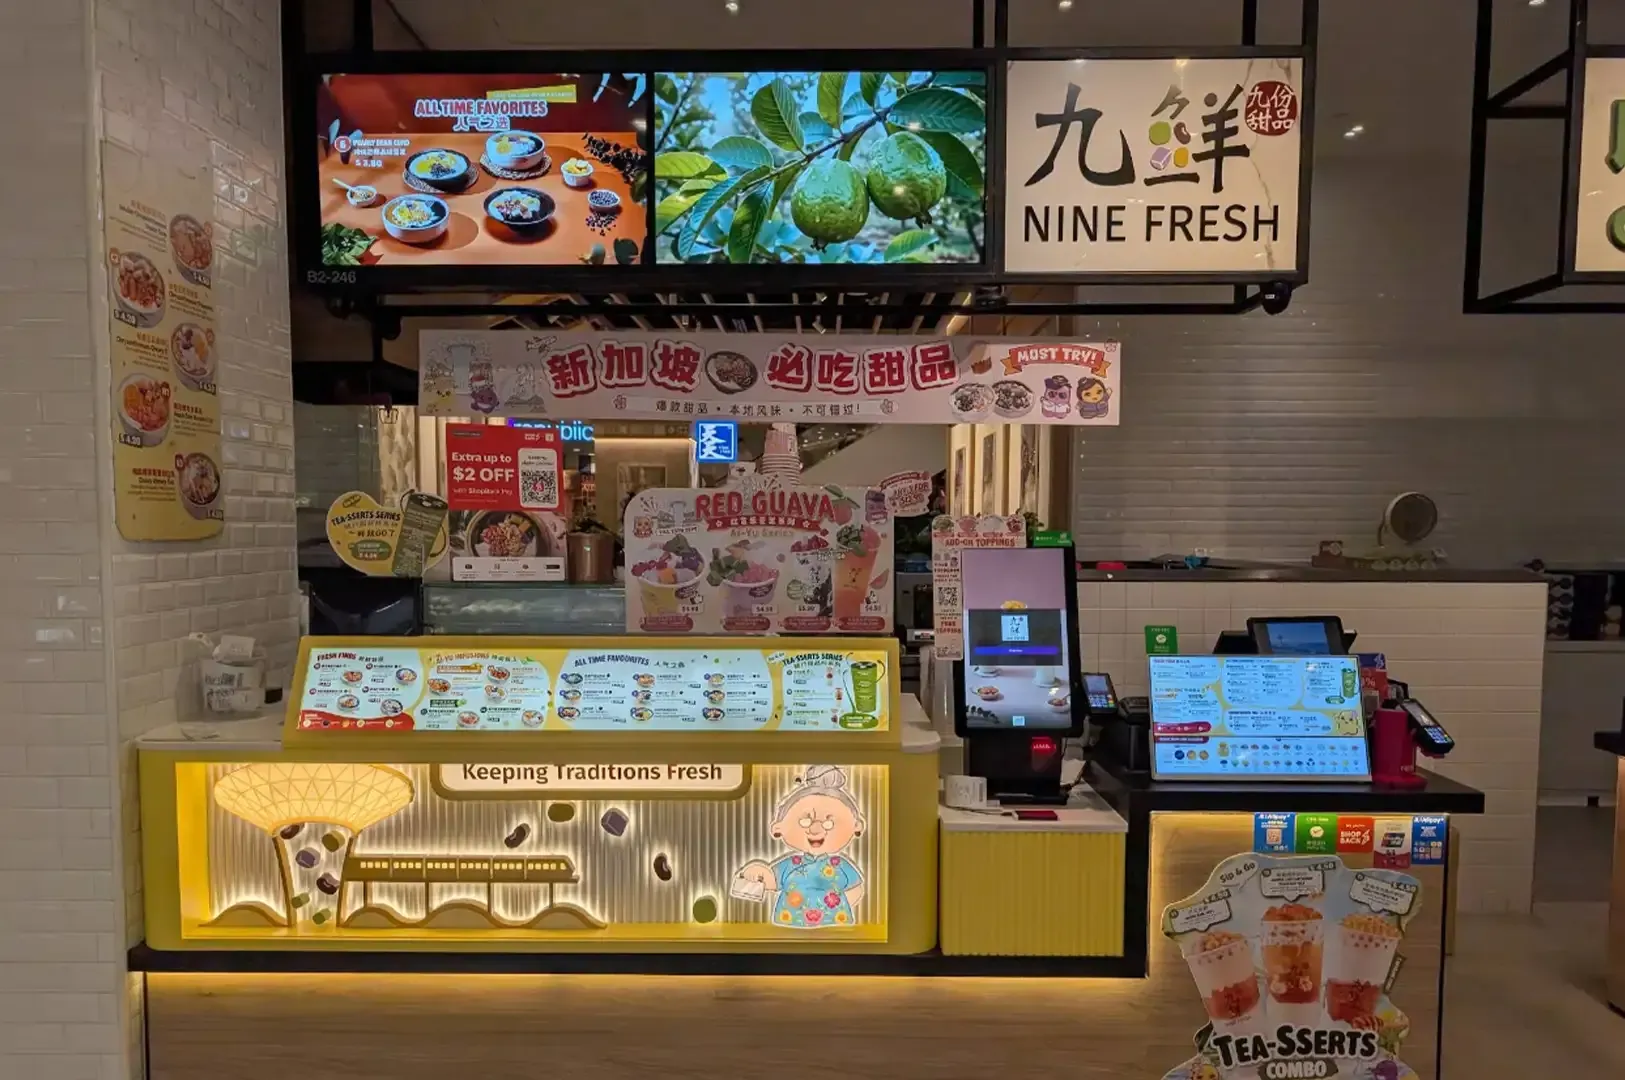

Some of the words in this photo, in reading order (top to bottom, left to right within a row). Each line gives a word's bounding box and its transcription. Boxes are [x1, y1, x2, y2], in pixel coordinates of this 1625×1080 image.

[1246, 84, 1294, 109] 九份
[416, 100, 441, 116] ALL
[441, 100, 475, 115] TIME
[477, 100, 547, 116] FAVORITES
[1246, 108, 1294, 130] 甜品
[1024, 205, 1126, 242] NINE
[1145, 204, 1280, 242] FRESH
[307, 271, 356, 284] B2-246
[1062, 348, 1097, 364] TRY!
[545, 343, 703, 392] 新加坡
[766, 341, 959, 391] 必吃甜品
[451, 452, 482, 462] Extra
[485, 455, 498, 464] up
[500, 453, 512, 463] to
[453, 465, 476, 482] $2
[480, 467, 514, 482] OFF
[695, 491, 743, 520] RED
[752, 489, 836, 522] GUAVA
[976, 537, 1016, 547] TOPPINGS
[574, 658, 587, 668] ALL
[588, 654, 606, 664] TIME
[463, 763, 549, 785] Keeping
[554, 763, 661, 780] Traditions
[667, 763, 723, 780] Fresh
[1219, 871, 1235, 883] Sip
[1236, 867, 1242, 876] &
[1243, 861, 1256, 871] Go
[1213, 1025, 1377, 1067] TEA-SSERTS
[1266, 1060, 1327, 1079] COMBO
